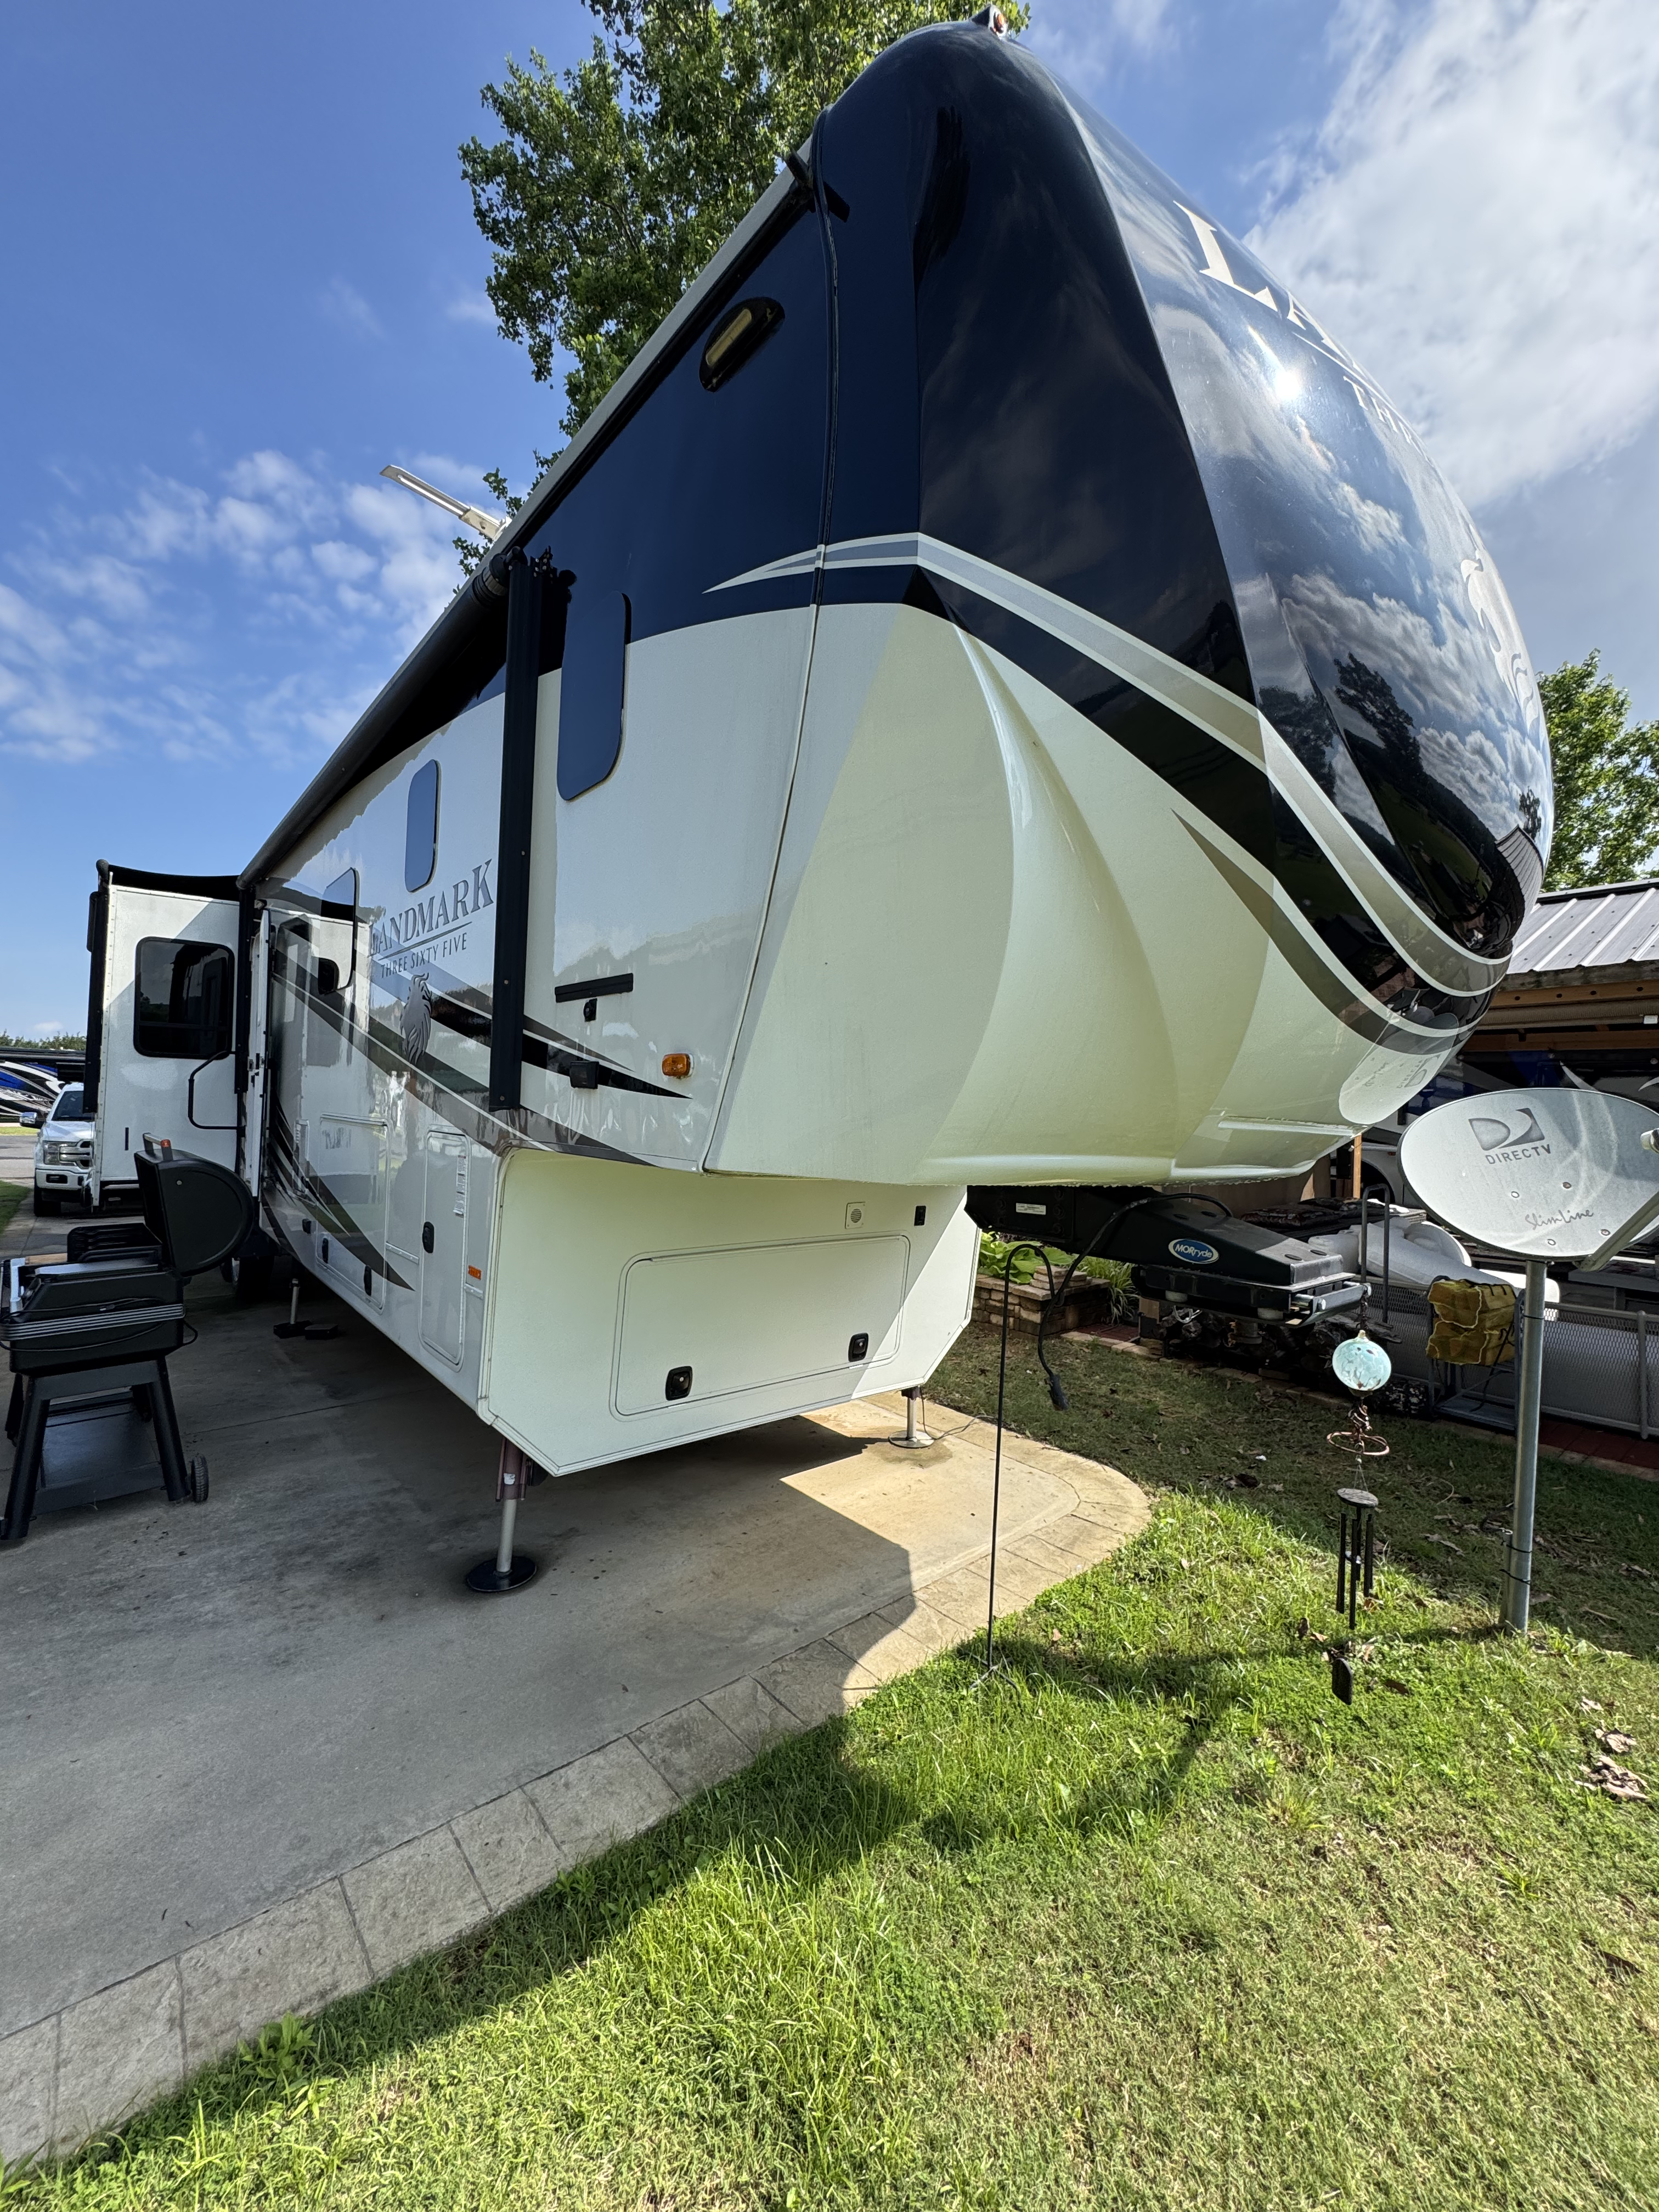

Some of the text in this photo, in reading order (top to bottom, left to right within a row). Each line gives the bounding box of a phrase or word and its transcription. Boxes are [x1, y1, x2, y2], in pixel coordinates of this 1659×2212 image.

[368, 859, 494, 958] LANDMARK
[381, 933, 467, 978] THREE SIXTY FIVE
[1485, 1143, 1551, 1165] DIRECTV
